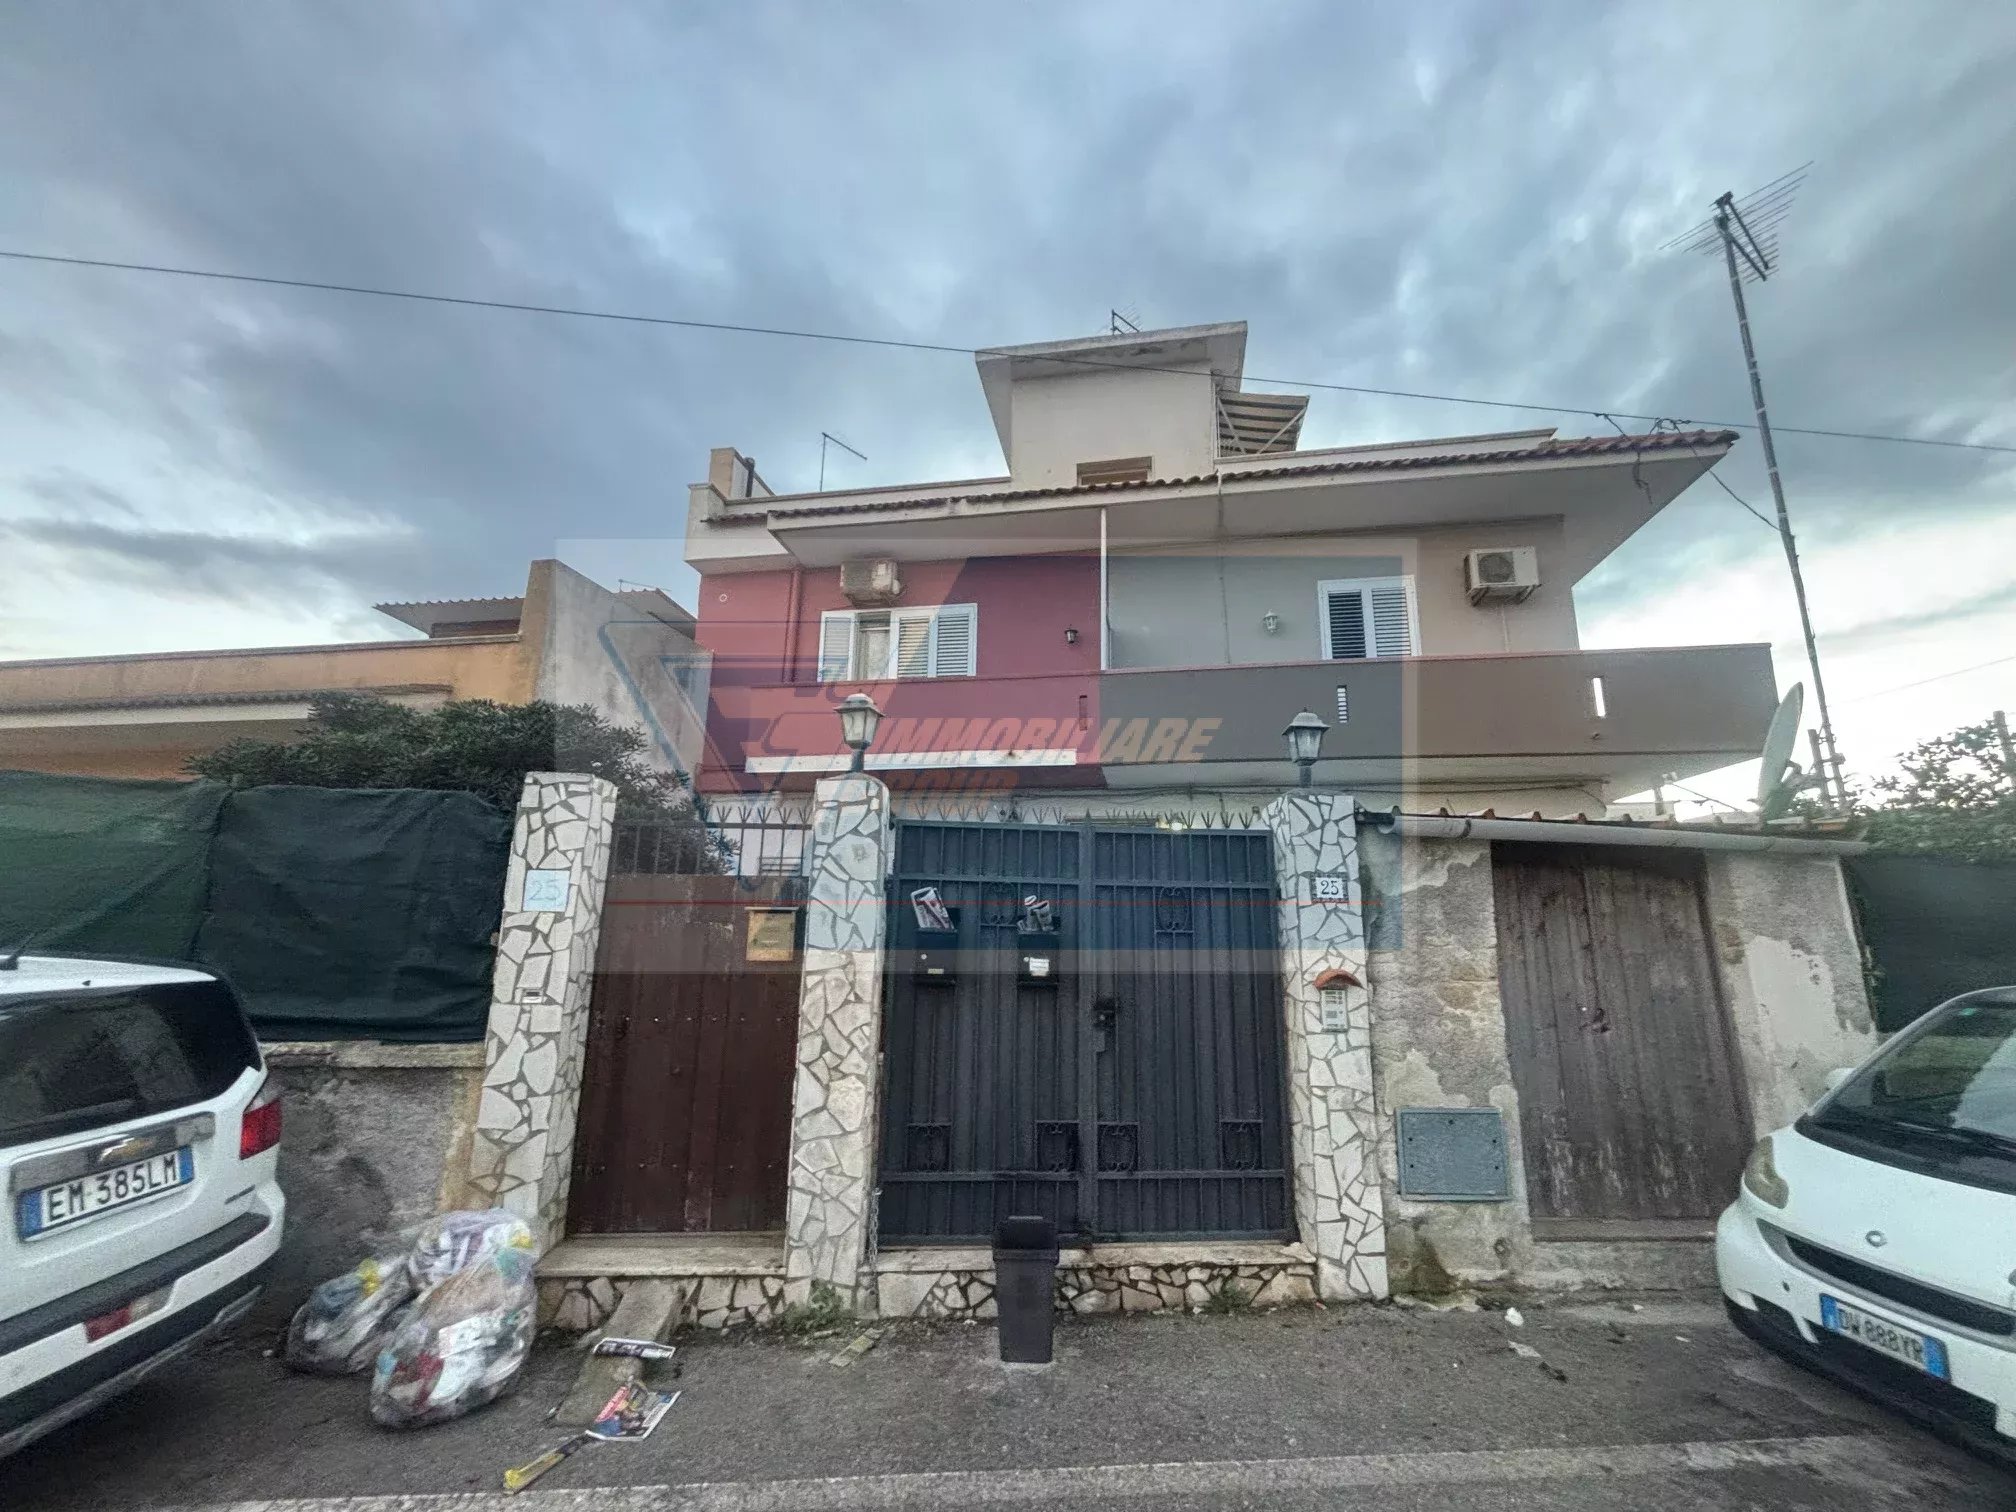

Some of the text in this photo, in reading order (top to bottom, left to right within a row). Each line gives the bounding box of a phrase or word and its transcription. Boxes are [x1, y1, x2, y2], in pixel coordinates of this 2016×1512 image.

[528, 880, 562, 901] 25
[1320, 880, 1339, 895] 25
[49, 1153, 177, 1221] EM 385LM
